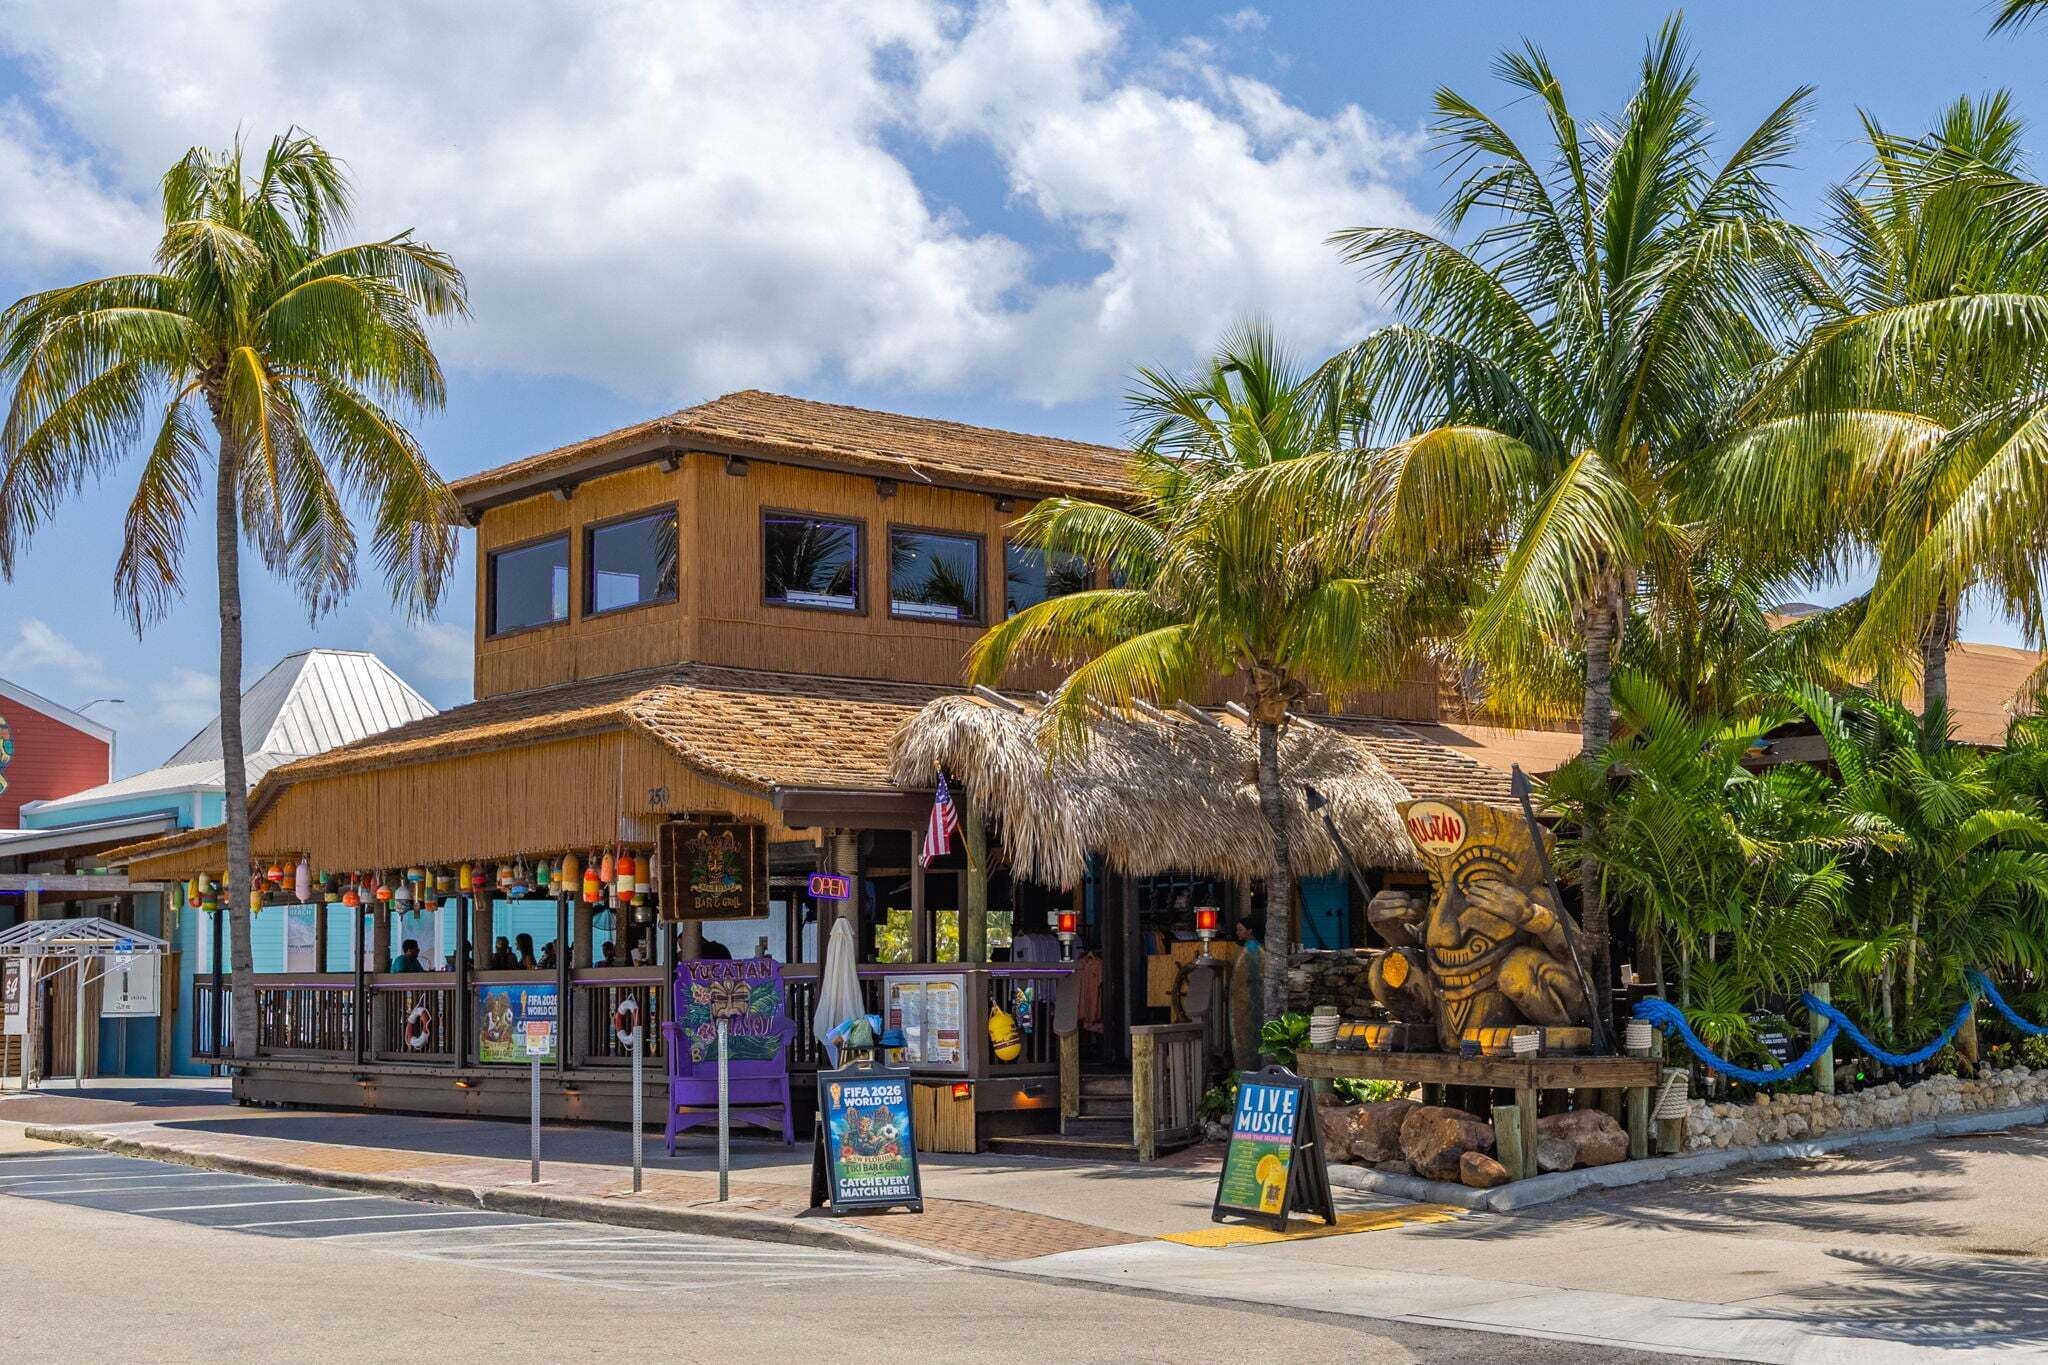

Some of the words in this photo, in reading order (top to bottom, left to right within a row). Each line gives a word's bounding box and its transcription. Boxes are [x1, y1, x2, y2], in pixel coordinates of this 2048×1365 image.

[810, 876, 848, 898] OPEN
[687, 961, 773, 980] YUCATAN
[528, 995, 541, 1006] FIFA
[527, 1006, 547, 1016] WORLD
[843, 1087, 870, 1098] FIFA
[871, 1085, 901, 1097] 2026
[844, 1097, 882, 1107] WORLD
[883, 1095, 903, 1105] CUP
[1243, 1087, 1294, 1113] LIVE
[1237, 1110, 1294, 1134] MUSIC!
[863, 1163, 878, 1172] BAR
[839, 1177, 875, 1187] CATCH
[875, 1175, 910, 1186] EVERY
[840, 1187, 879, 1198] MATCH
[879, 1185, 911, 1196] HERE!
